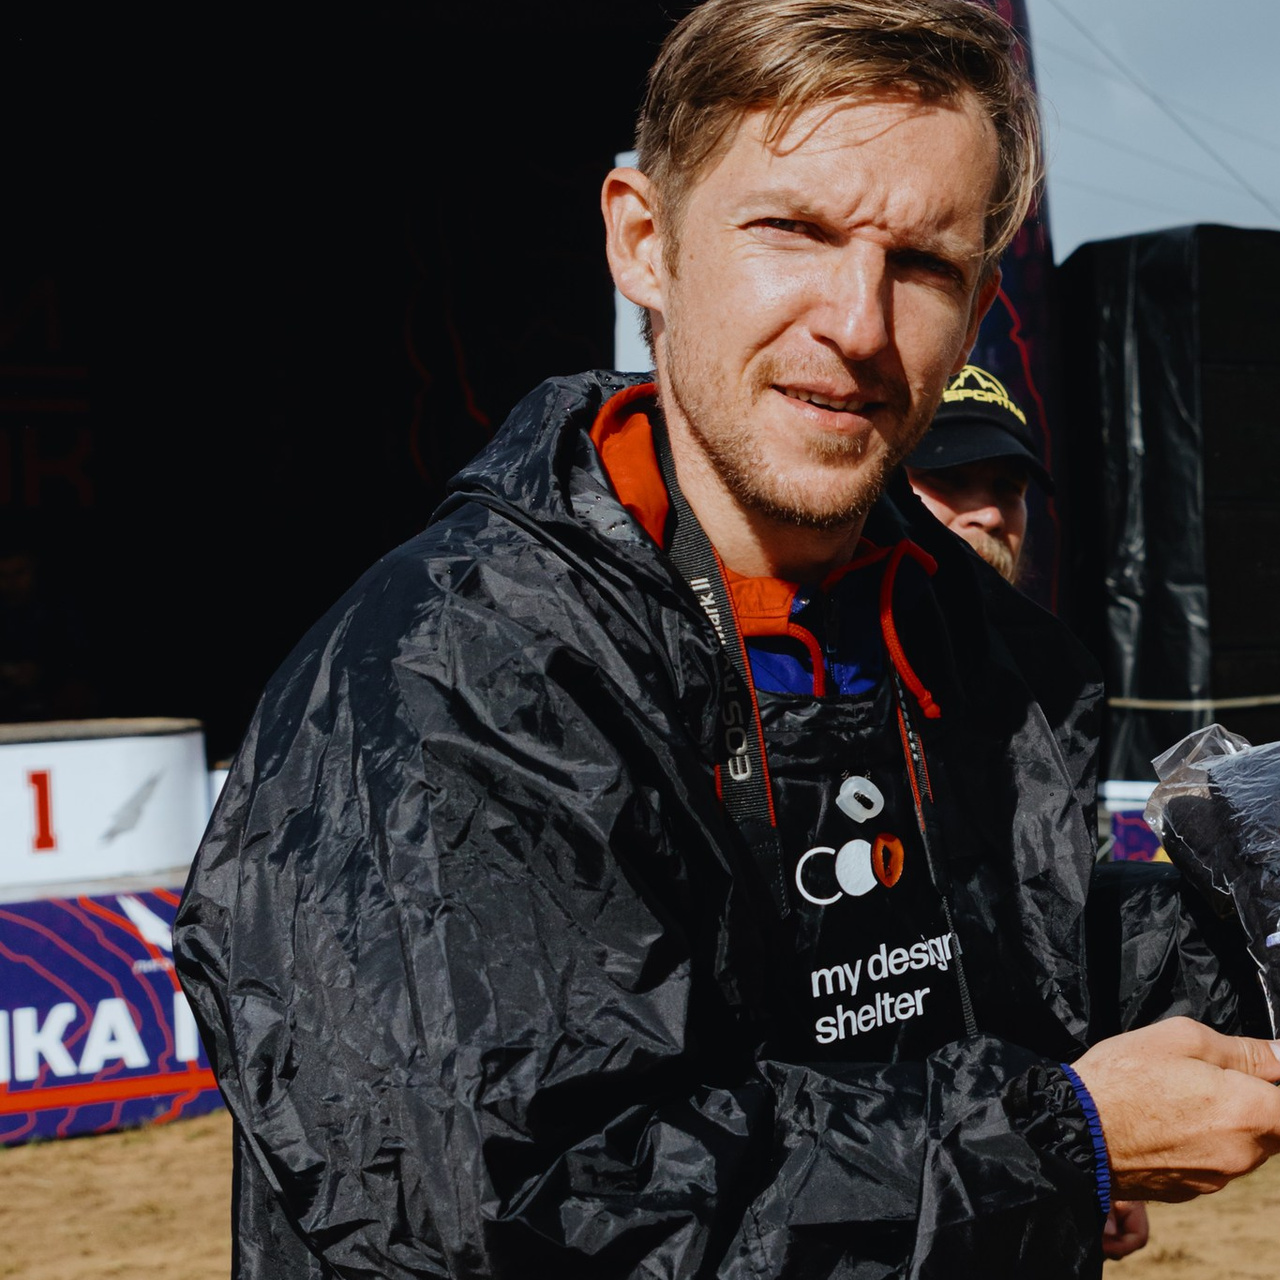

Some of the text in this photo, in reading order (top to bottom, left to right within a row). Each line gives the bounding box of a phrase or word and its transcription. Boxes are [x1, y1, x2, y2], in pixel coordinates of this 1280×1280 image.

[27, 770, 57, 852] 1
[811, 959, 862, 998] my
[815, 987, 931, 1044] shelter
